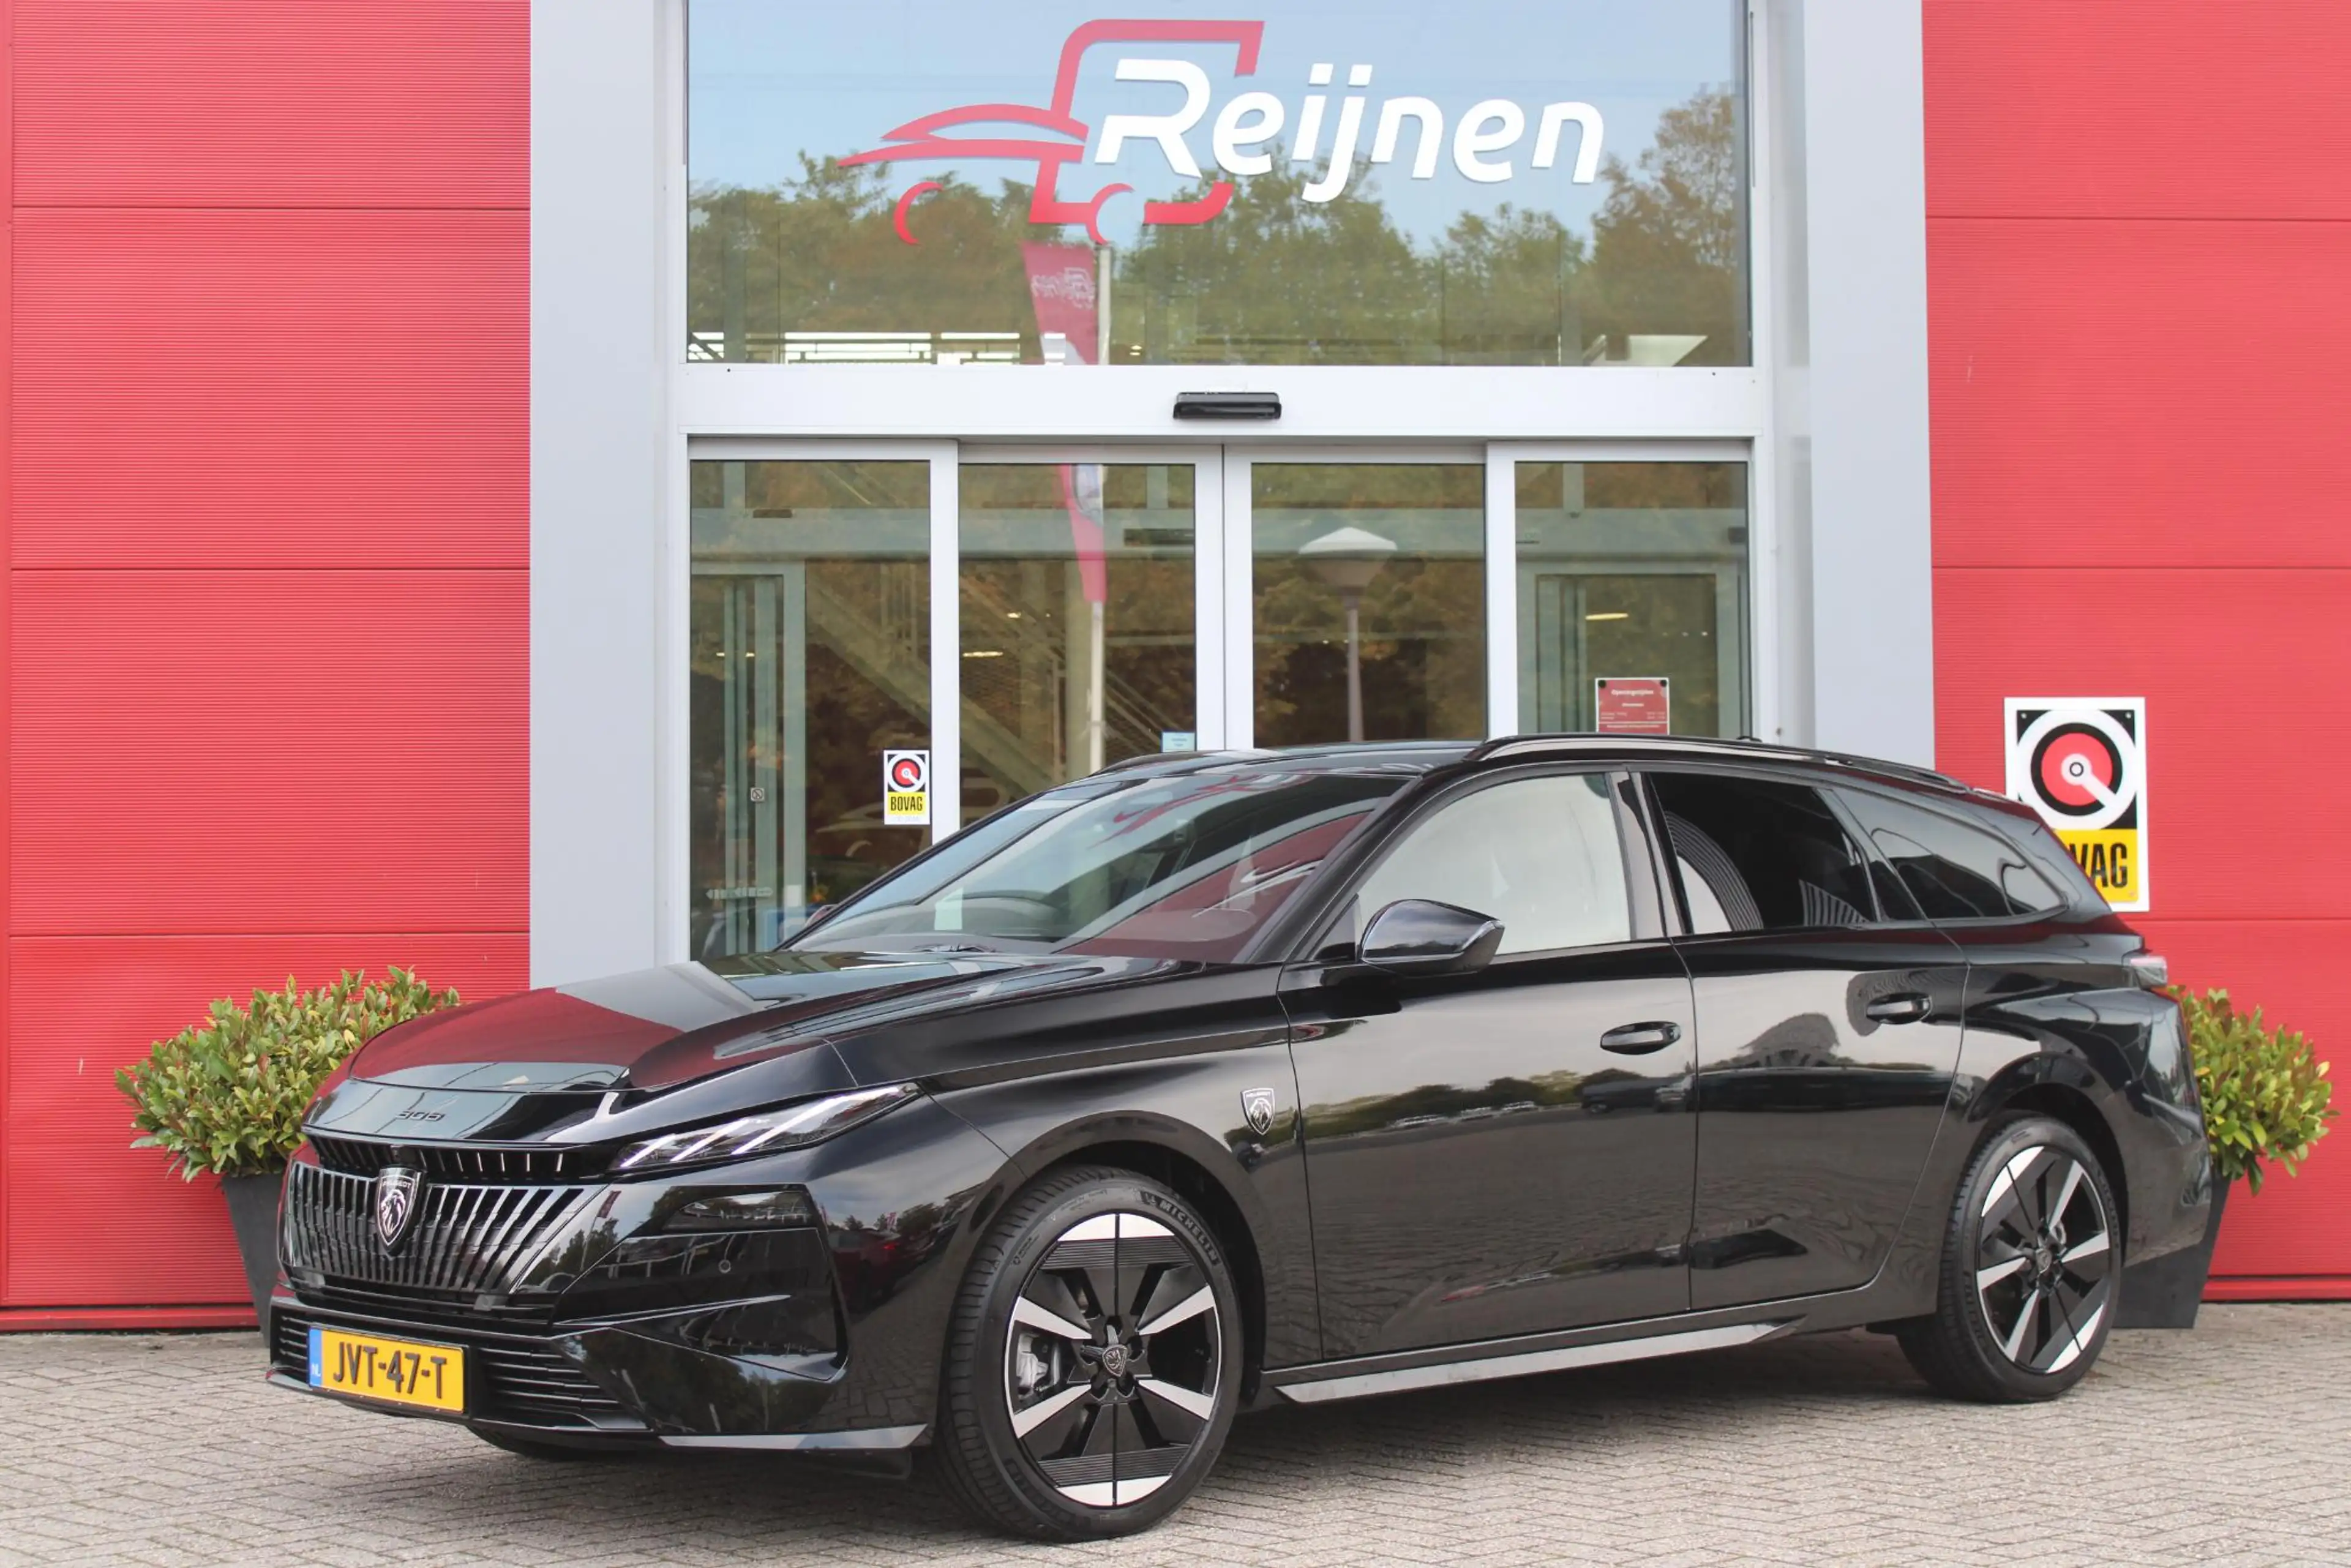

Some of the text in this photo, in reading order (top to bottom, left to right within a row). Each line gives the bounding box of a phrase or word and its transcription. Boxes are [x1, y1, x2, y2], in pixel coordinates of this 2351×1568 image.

[1094, 58, 1605, 203] Reijnen
[890, 796, 923, 811] BOVAG
[2069, 842, 2129, 888] VAG
[1160, 1199, 1218, 1261] MICHELIN
[333, 1341, 447, 1399] JVT-47-T
